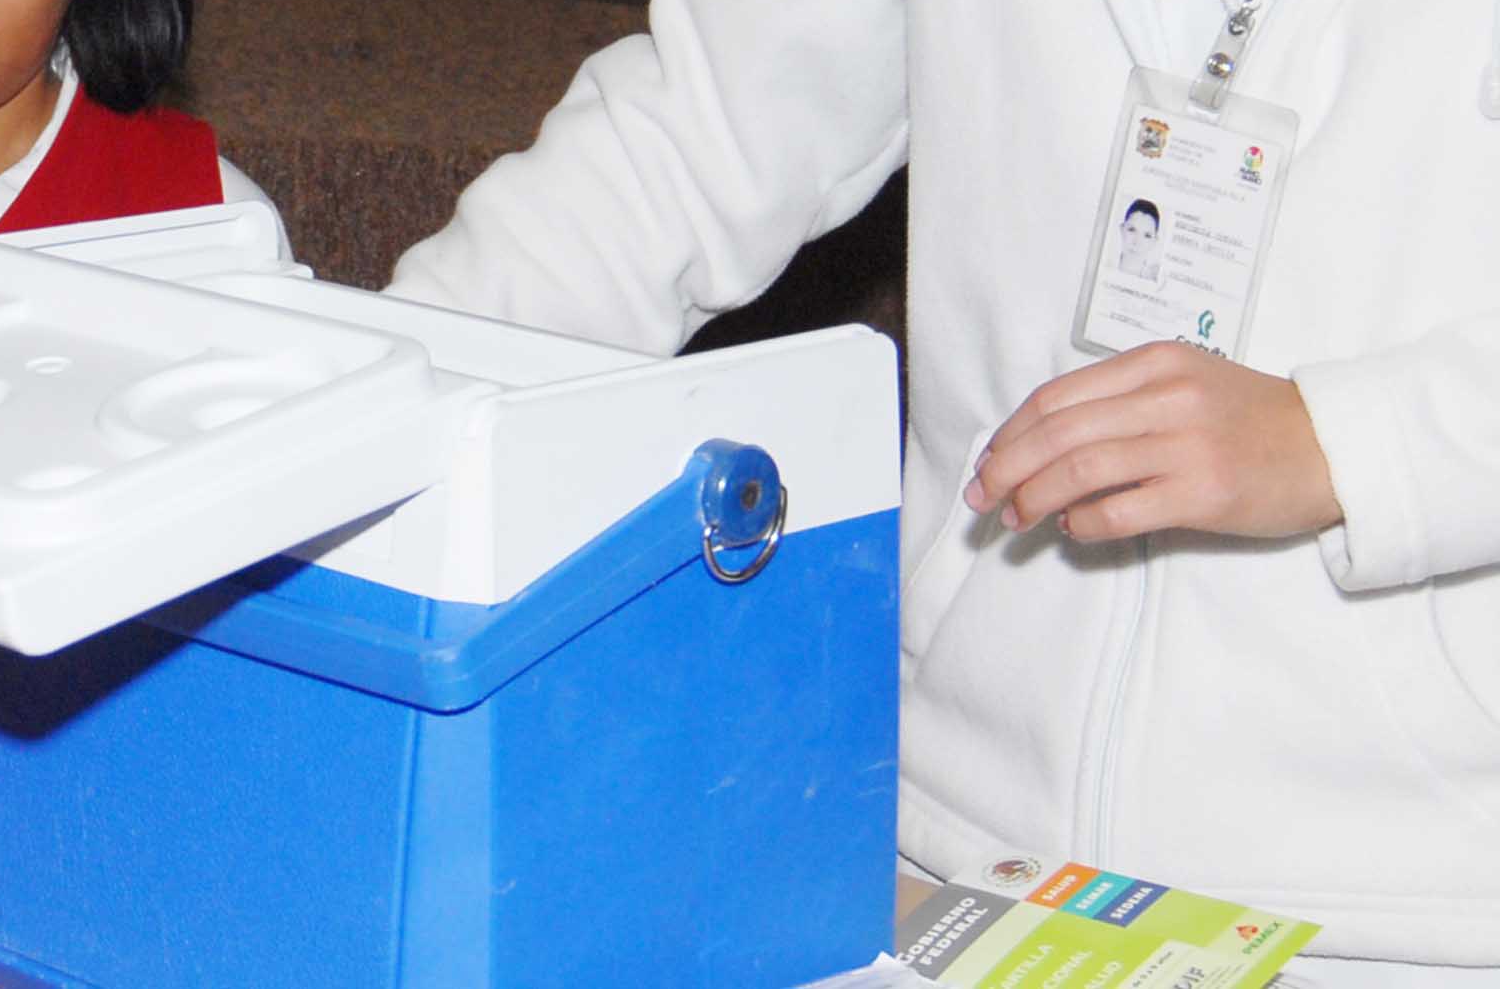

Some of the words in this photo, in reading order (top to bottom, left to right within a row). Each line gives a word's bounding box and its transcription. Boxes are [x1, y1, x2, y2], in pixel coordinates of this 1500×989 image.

[1041, 874, 1077, 901] SALUD
[1110, 887, 1153, 919] SEDENA
[896, 897, 976, 964] GOBIERNO
[919, 908, 989, 965] FEDERAL
[1242, 921, 1283, 954] PEMEX
